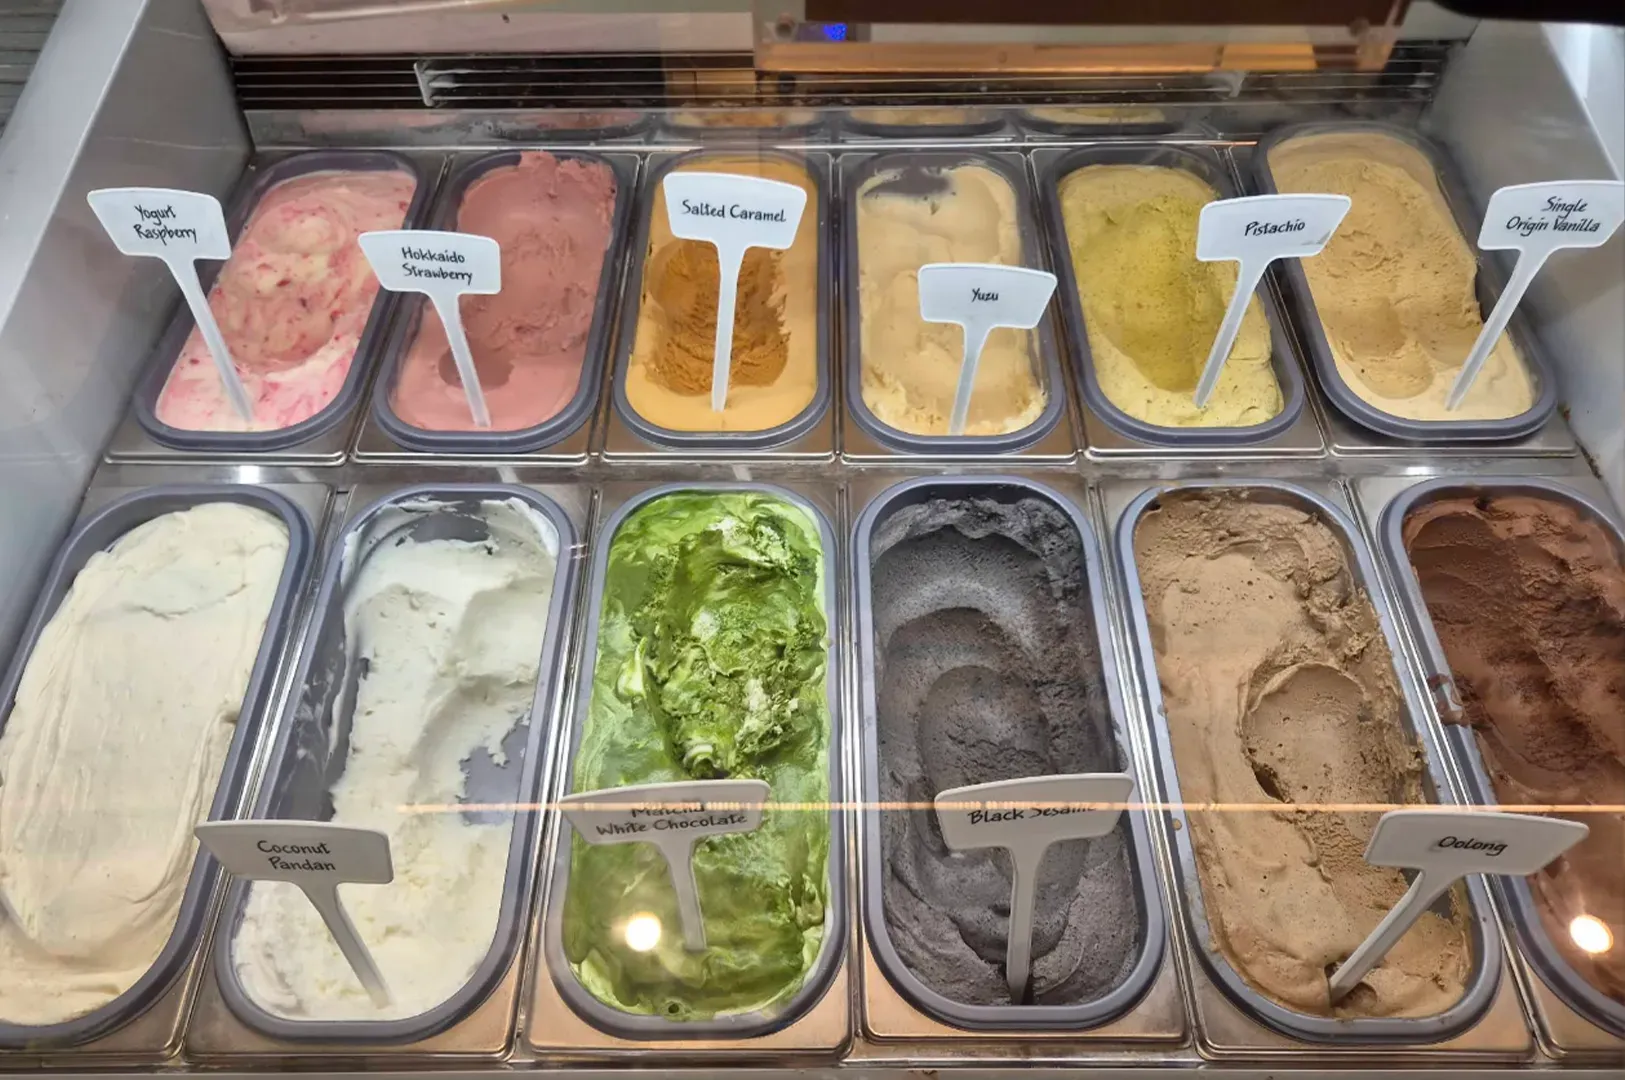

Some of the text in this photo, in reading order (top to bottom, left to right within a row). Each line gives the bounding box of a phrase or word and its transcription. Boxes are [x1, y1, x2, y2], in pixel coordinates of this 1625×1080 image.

[134, 204, 176, 226] Yogurt
[682, 199, 787, 222] Salted Caramel
[1541, 195, 1588, 219] Single
[133, 223, 197, 246] Raspberry
[1244, 218, 1306, 236] Pistachio
[1505, 215, 1601, 237] Origin Vanilla
[401, 246, 466, 264] Hokkaido
[402, 262, 473, 286] Strawberry
[970, 287, 999, 303] Yuzu
[596, 813, 748, 837] White Chocolate
[967, 807, 1025, 825] Black
[257, 840, 331, 855] Coconut
[1437, 835, 1508, 857] Oolong
[267, 855, 337, 871] Pandan
